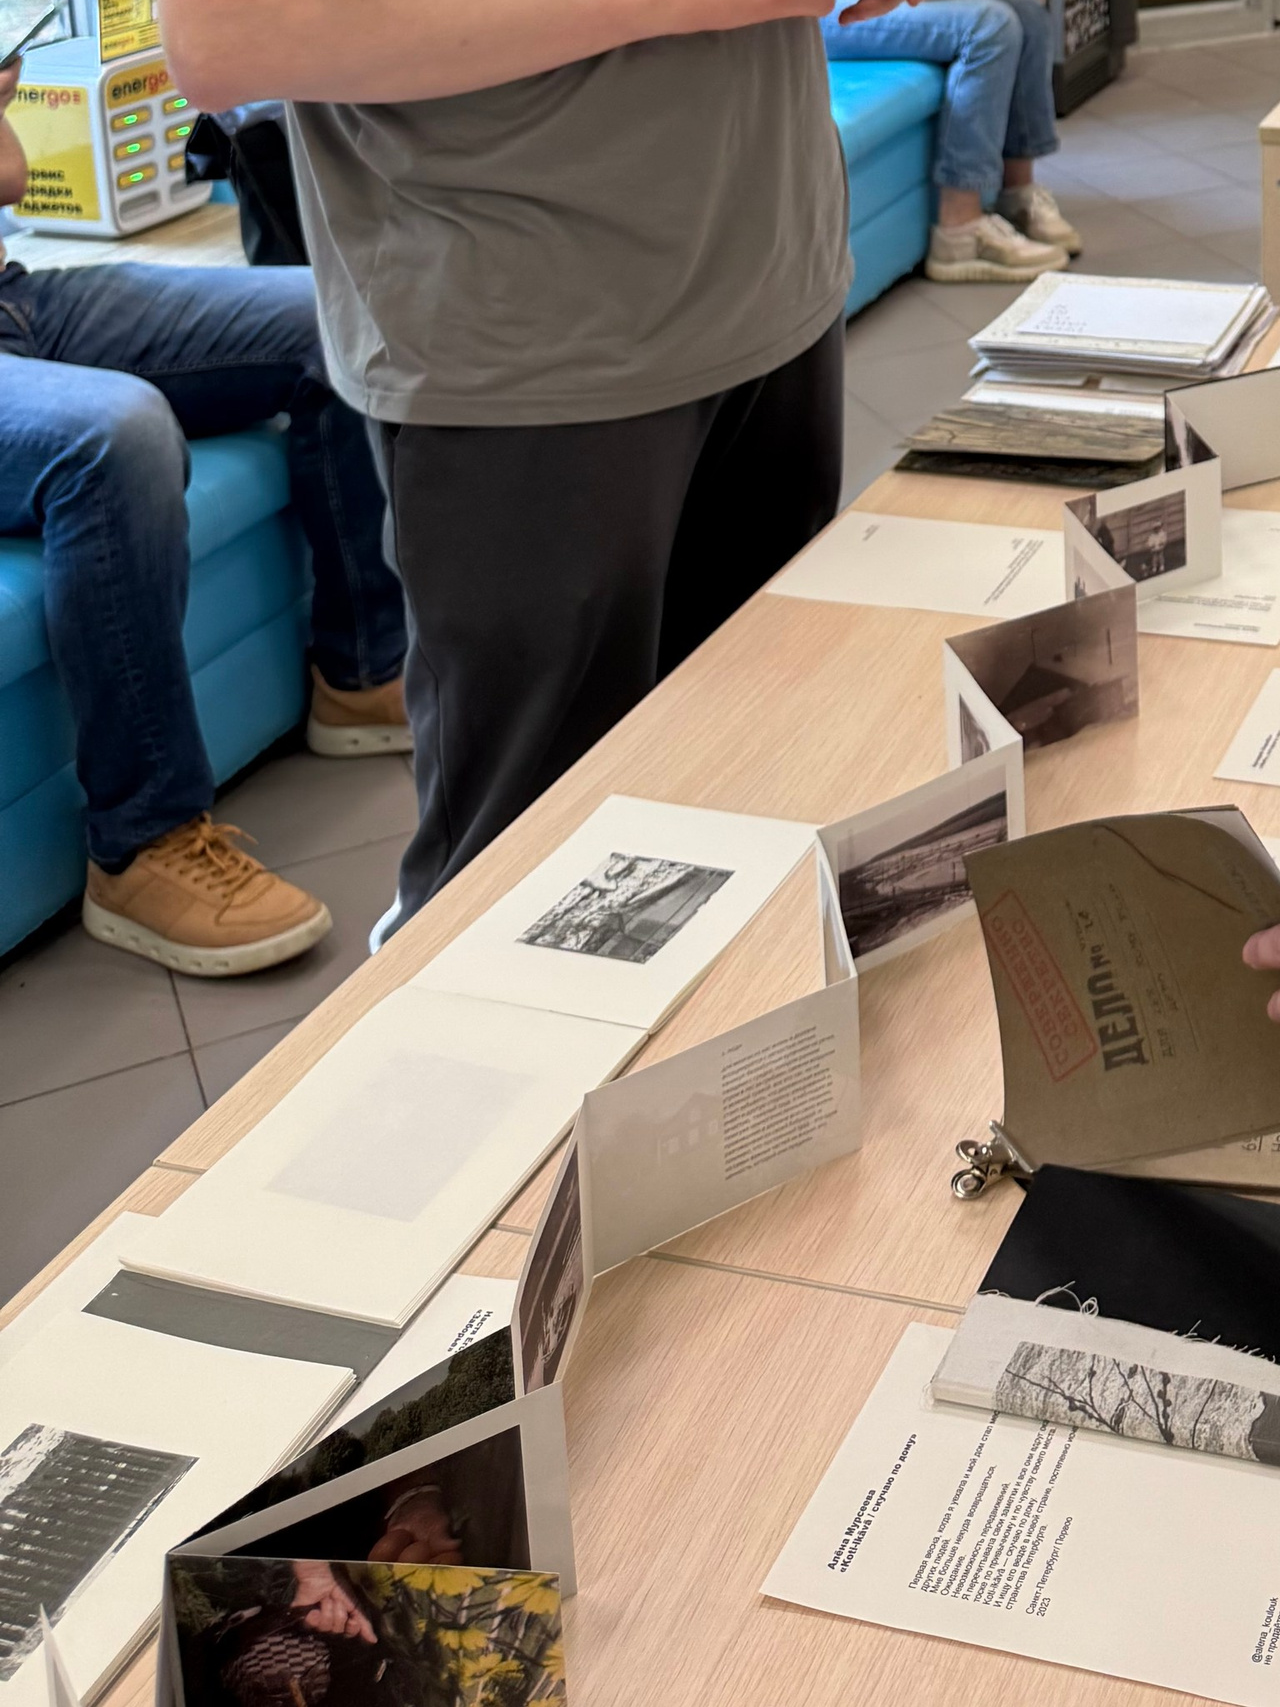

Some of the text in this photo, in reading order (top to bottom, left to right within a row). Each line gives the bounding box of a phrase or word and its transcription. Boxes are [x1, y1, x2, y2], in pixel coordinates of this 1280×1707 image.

[1031, 1451, 1046, 1474] своего
[1042, 1425, 1060, 1449] места.
[872, 1477, 894, 1512] скучаю
[891, 1462, 903, 1476] по
[897, 1433, 918, 1463] дому»
[1018, 1475, 1037, 1503] чувству
[827, 1490, 876, 1570] Алёна Мурсеева
[908, 1560, 929, 1589] Первая
[925, 1535, 942, 1559] весна,
[937, 1513, 952, 1533] когда
[950, 1480, 967, 1505] уехала
[966, 1458, 978, 1472] мой
[974, 1443, 985, 1458] дом
[981, 1426, 993, 1441] стал
[929, 1465, 997, 1594] Мне больше некуда возвращаться.
[966, 1538, 997, 1593] перечитывала
[992, 1519, 1005, 1536] свои
[1001, 1488, 1019, 1517] заметки
[1024, 1453, 1035, 1466] они
[1030, 1432, 1044, 1452] вдруг
[998, 1583, 1012, 1599] ищу
[1006, 1569, 1017, 1581] его
[1013, 1545, 1027, 1567] везде
[1026, 1515, 1040, 1537] новой
[1036, 1486, 1054, 1513] стране,
[1049, 1443, 1071, 1484] постепенно
[1006, 1529, 1023, 1557] скучаю
[1015, 1518, 1027, 1528] по
[1023, 1498, 1038, 1518] дому.
[1013, 1505, 1022, 1514] по
[921, 1538, 952, 1592] других людей.
[951, 1482, 1011, 1598] Невозможность передвижений.
[989, 1522, 1016, 1571] привычному
[1005, 1524, 1048, 1610] странства Петербурга.
[940, 1555, 967, 1596] Ожидание.
[973, 1582, 992, 1604] тоске
[984, 1570, 995, 1580] по
[1036, 1598, 1051, 1617] 2023
[1252, 1597, 1279, 1663] @alena_koulouk
[1264, 1654, 1273, 1665] не
